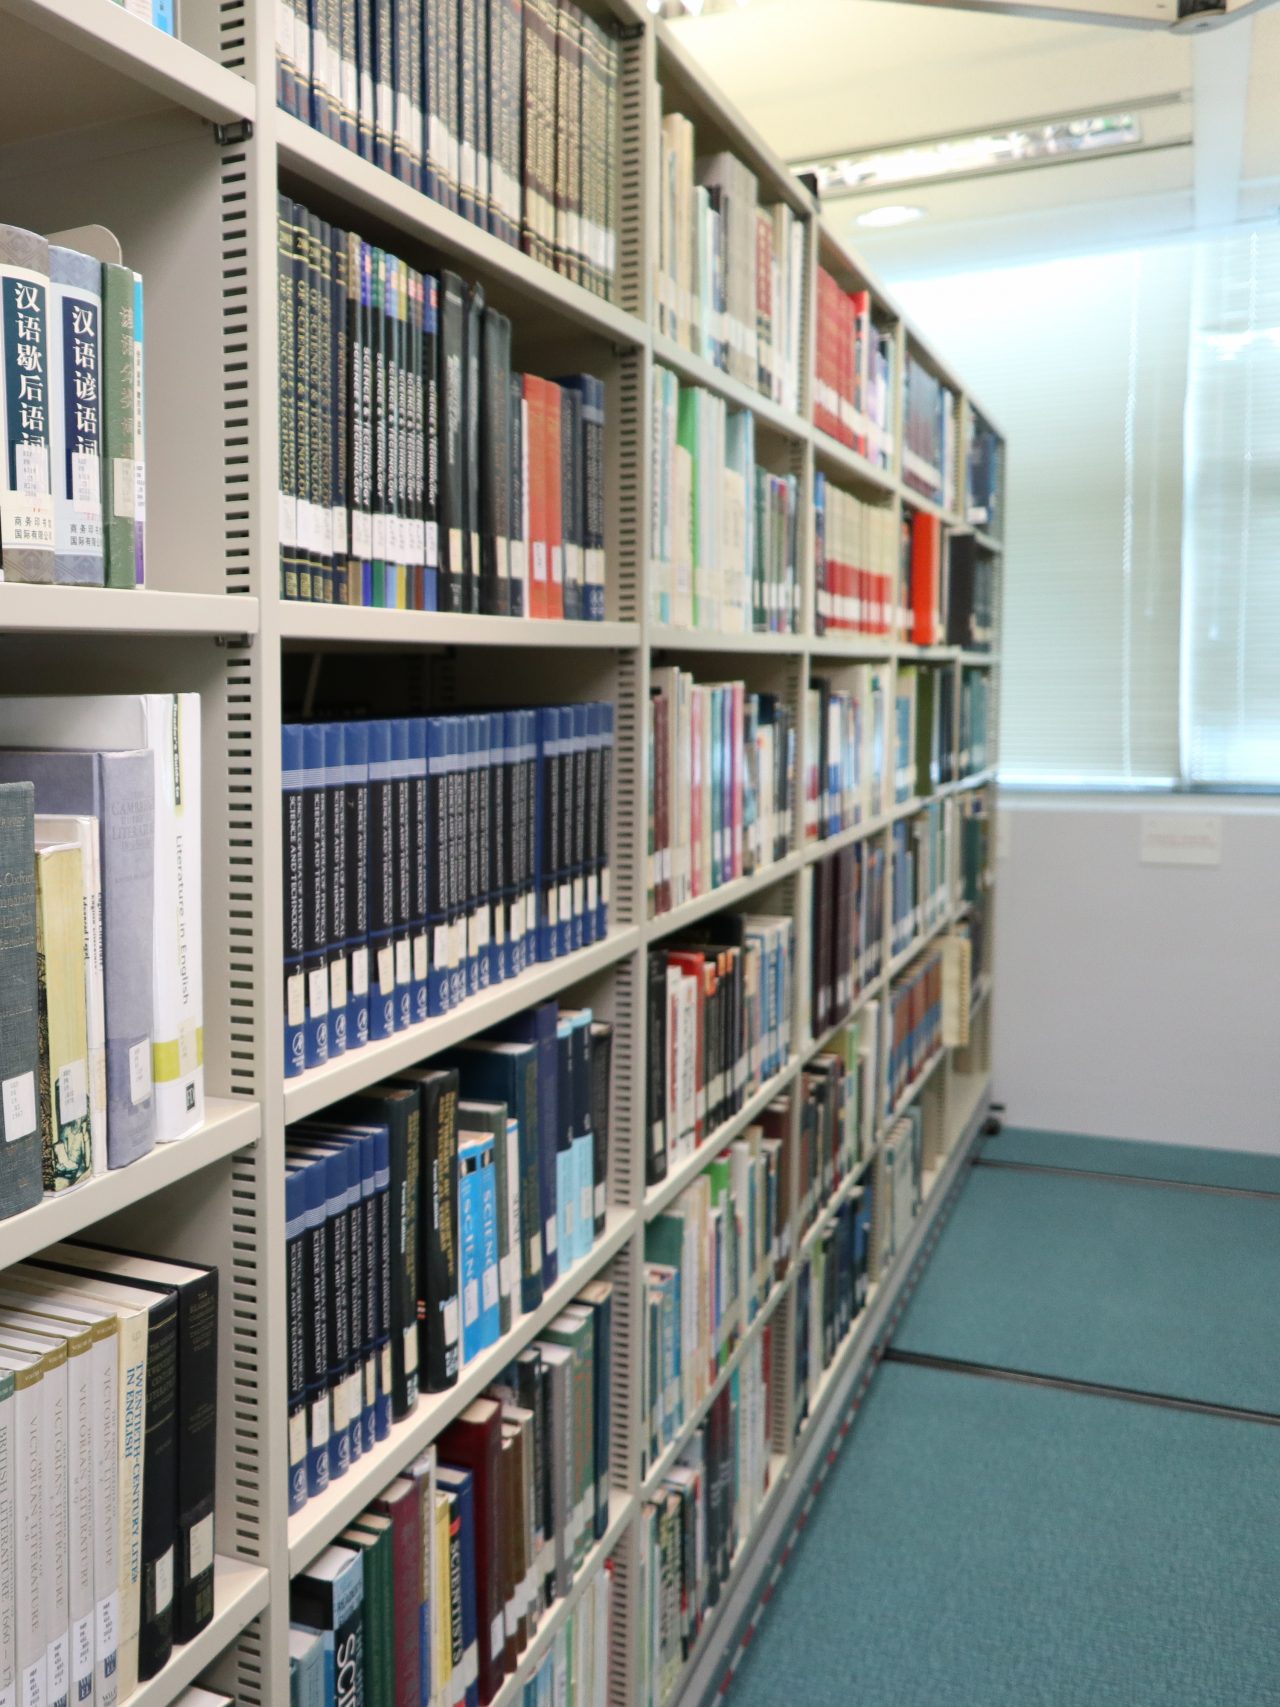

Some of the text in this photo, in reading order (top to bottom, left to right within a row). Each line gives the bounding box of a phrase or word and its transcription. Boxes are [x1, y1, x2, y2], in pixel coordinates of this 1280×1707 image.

[297, 305, 307, 379] SCIENCE
[353, 341, 362, 505] SCIENCE TECHNOLOGY
[363, 346, 371, 506] SCIENCE TECHNOLOGY
[377, 420, 385, 498] TECHNOLOGY
[175, 834, 191, 1006] Literature in English
[290, 873, 298, 950] TECHNOLOGY
[79, 1383, 89, 1589] VICTORIAN LITERATURE
[103, 1367, 113, 1569] VICTORIAN LITERATURE
[124, 1367, 136, 1458] IN ENGLISH
[131, 1360, 144, 1537] TWENTIETH-CENTURY
[0, 1424, 11, 1603] BRITISH LITERATURE
[29, 1415, 40, 1633] VICTORIAN LITERATURE
[54, 1398, 65, 1610] VICTORIAN LITERATURE
[451, 1541, 464, 1663] SCIENTISTS
